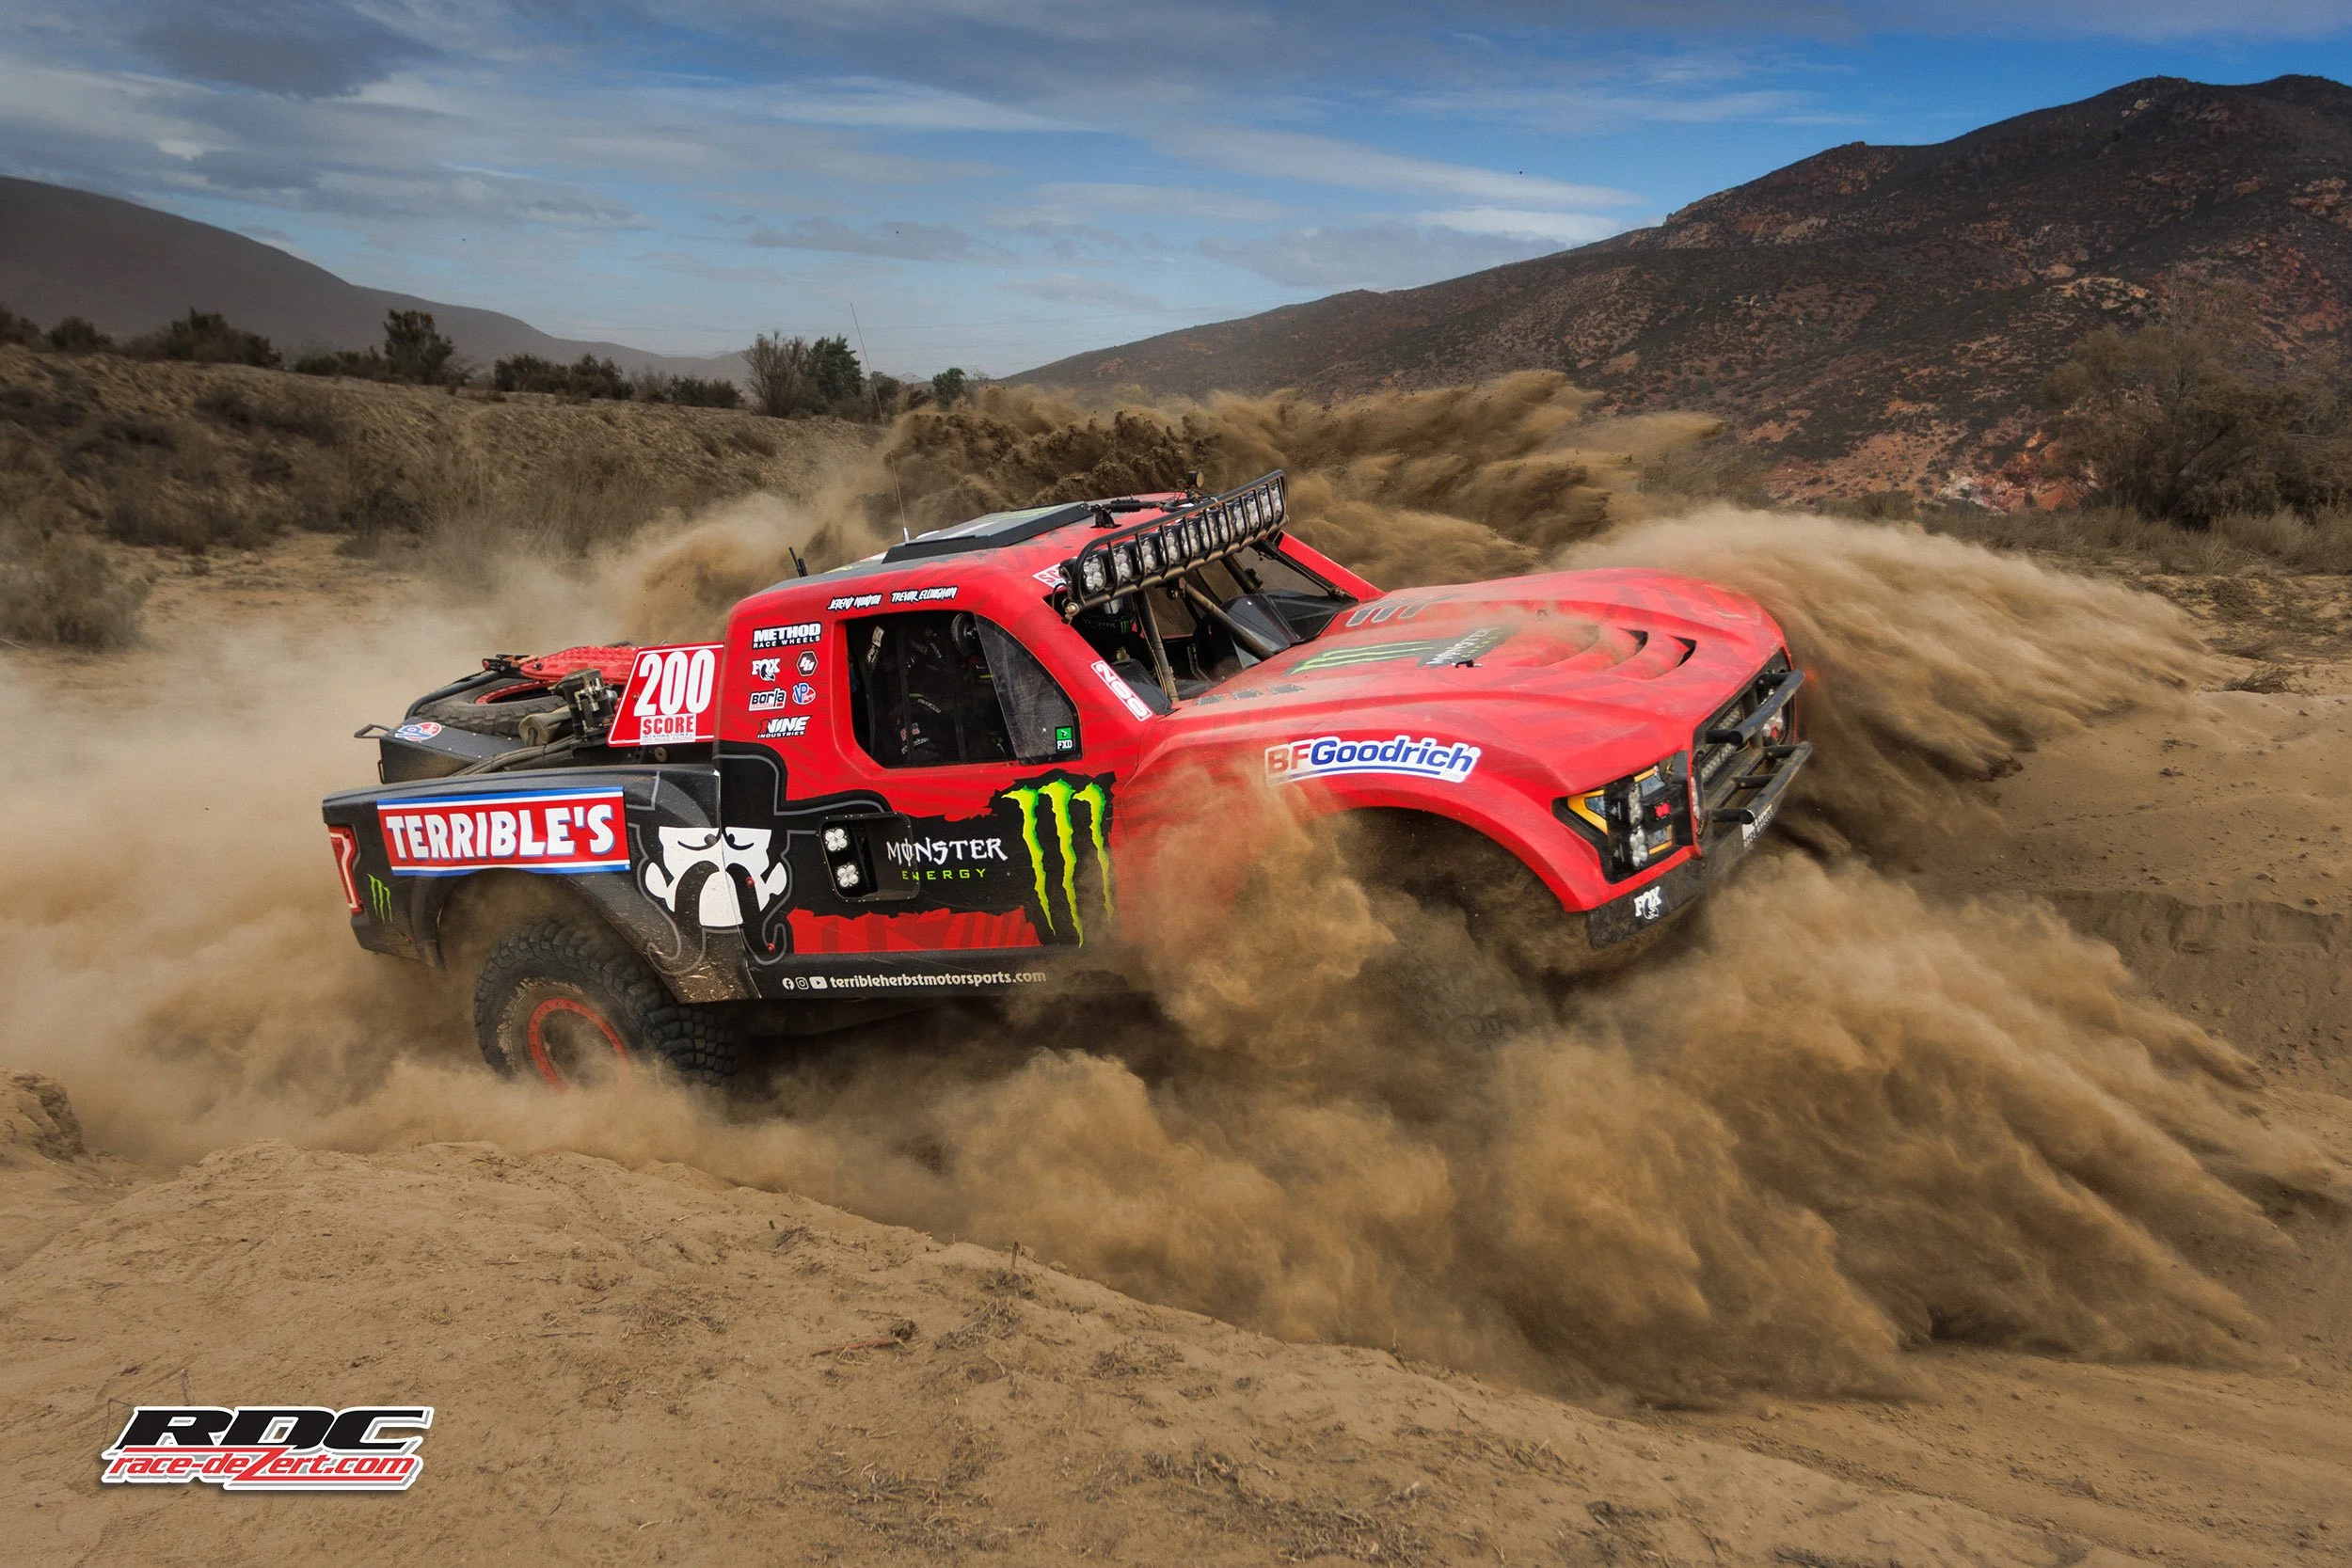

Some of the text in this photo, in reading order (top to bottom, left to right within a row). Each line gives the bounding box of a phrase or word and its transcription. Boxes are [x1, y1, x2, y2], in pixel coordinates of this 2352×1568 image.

[753, 635, 820, 649] RACE WHEELS
[754, 623, 821, 642] METHOD
[751, 658, 780, 681] FOX
[633, 648, 716, 717] 200
[792, 682, 809, 705] VP
[1094, 661, 1149, 719] 200
[643, 716, 694, 736] SCORE
[756, 730, 804, 738] INDUSTRIES
[1057, 739, 1073, 750] FXD
[1267, 738, 1474, 775] BFGoodrich
[385, 803, 616, 861] TERRIBLE'S
[886, 836, 1008, 867] MONSTER
[902, 867, 986, 880] ENERGY
[1634, 886, 1662, 919] FOX
[829, 971, 1046, 988] terribleherbstmotorsports.com
